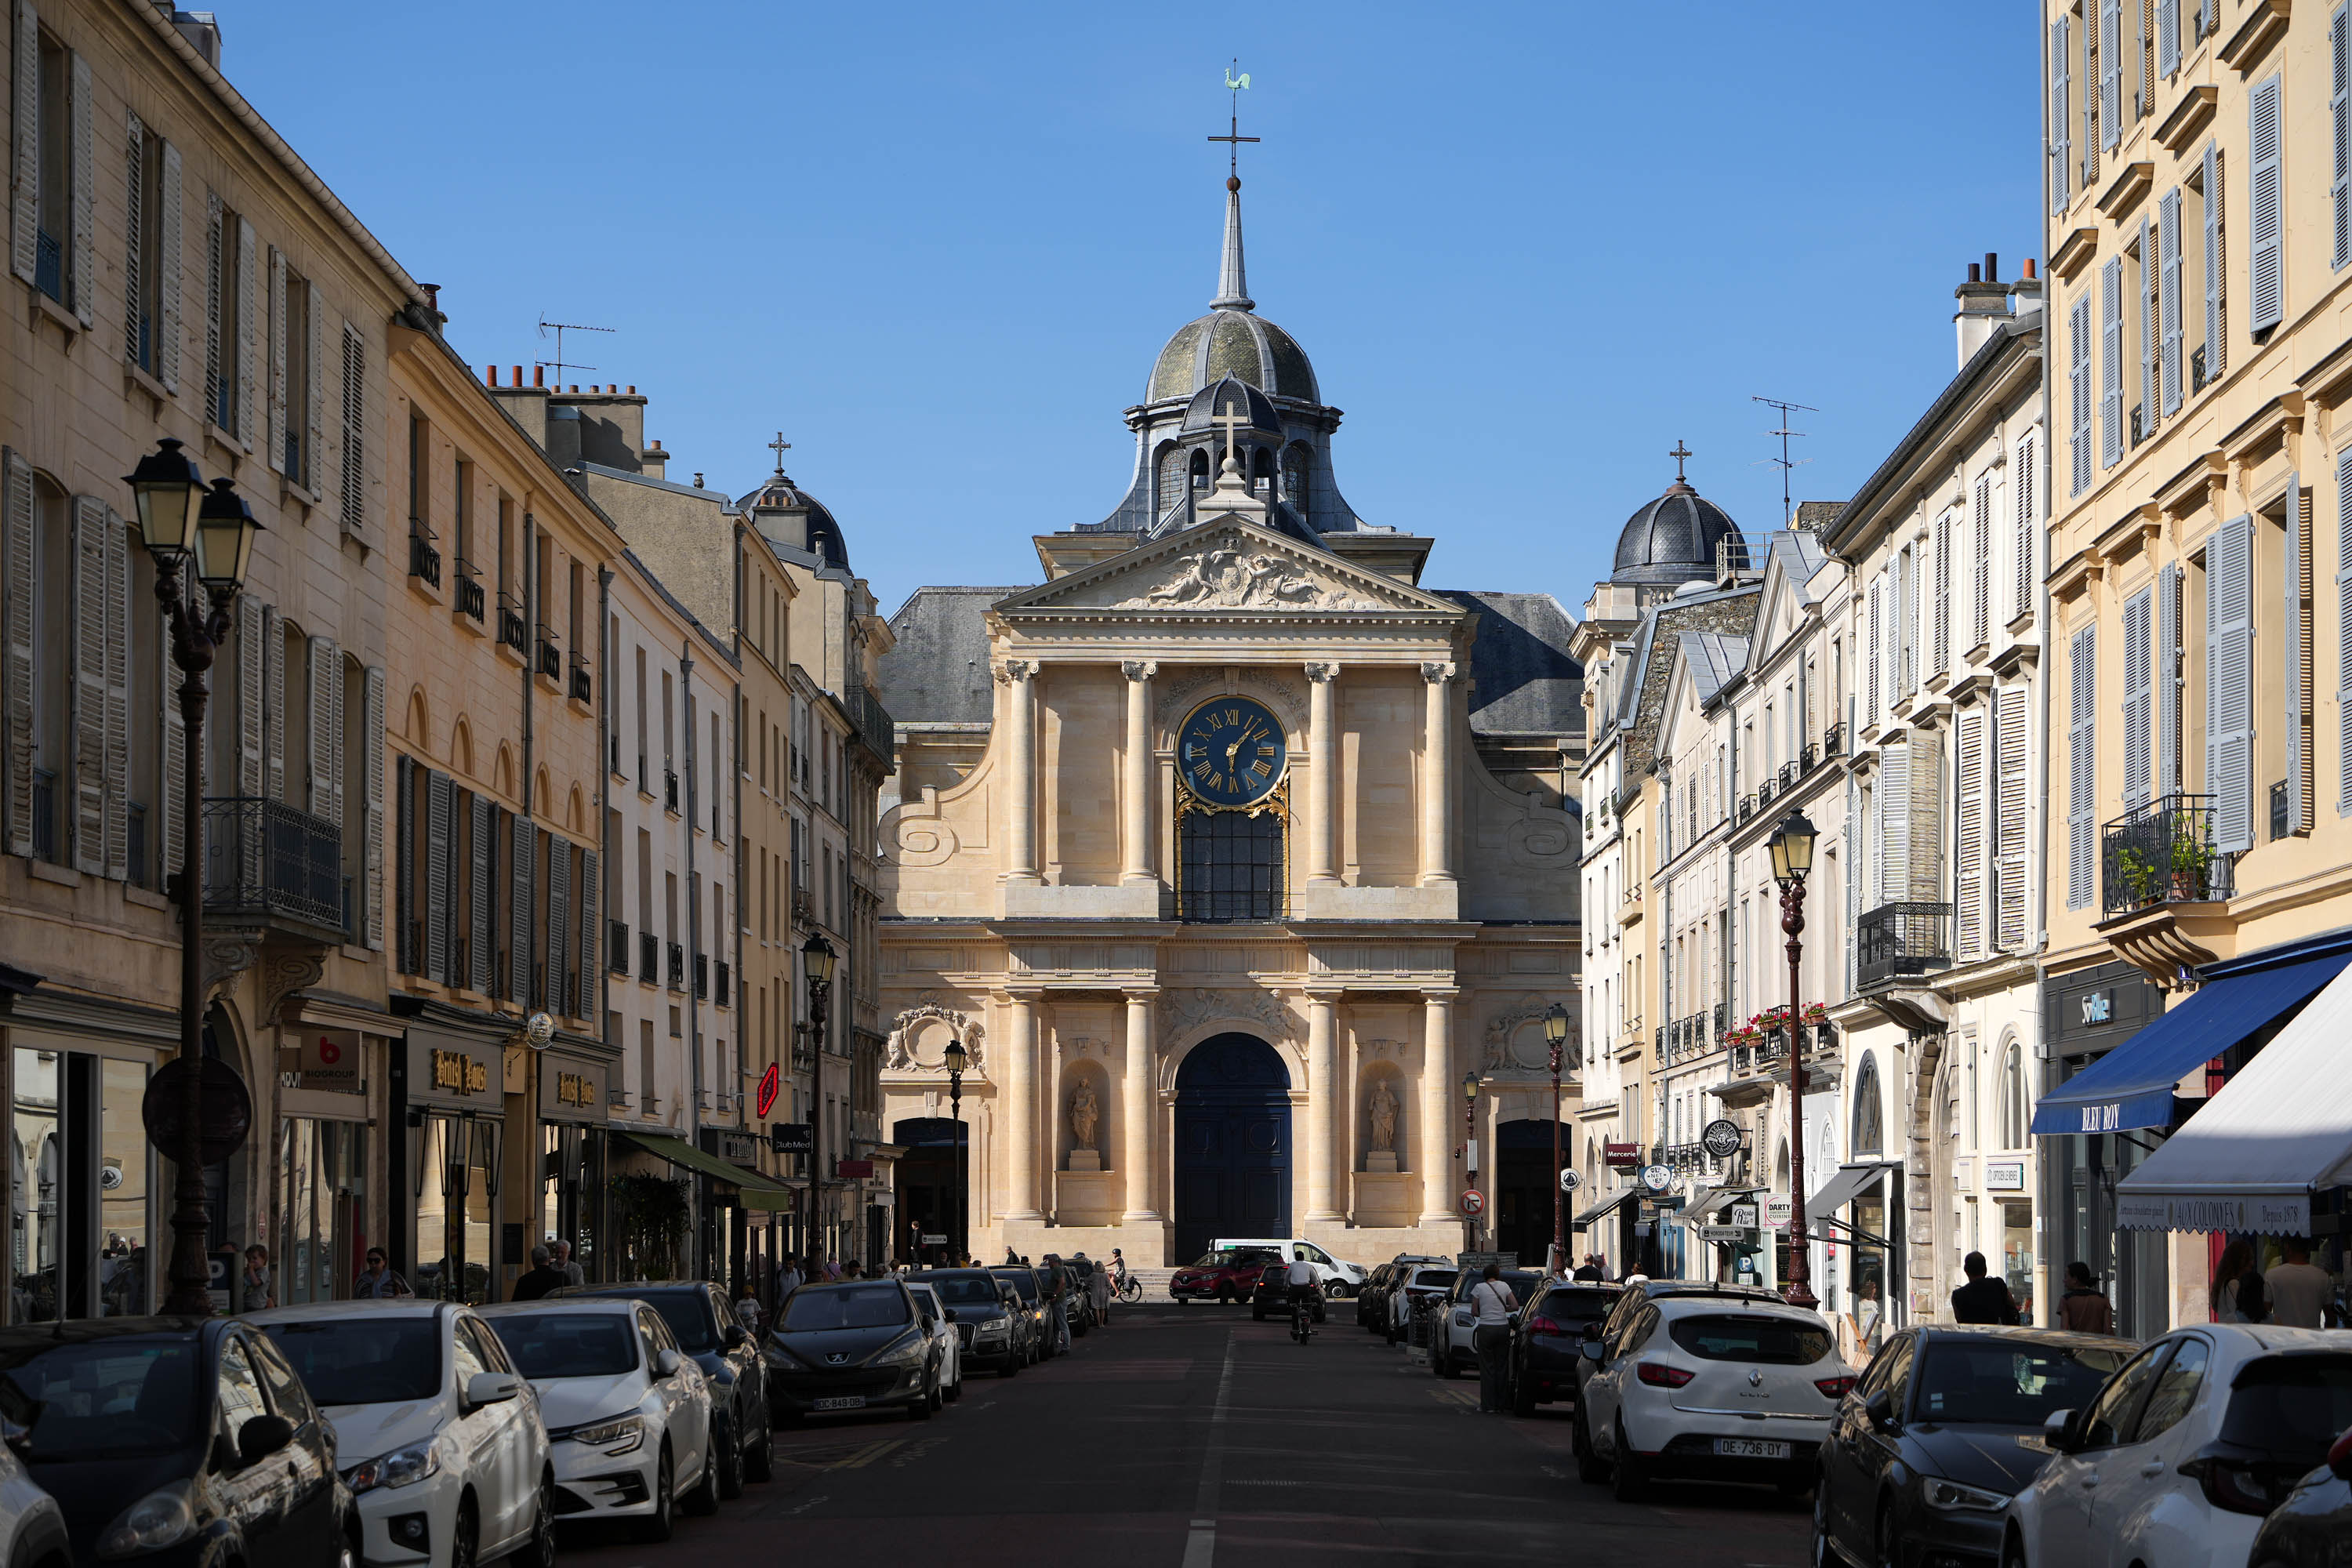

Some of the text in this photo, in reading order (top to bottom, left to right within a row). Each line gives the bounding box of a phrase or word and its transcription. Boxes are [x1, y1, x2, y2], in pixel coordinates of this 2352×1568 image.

[1206, 713, 1223, 731] XI
[1225, 709, 1240, 725] XII
[1193, 728, 1212, 742] X
[1253, 728, 1270, 740] II
[1190, 746, 1207, 757] IX
[1258, 746, 1275, 757] III
[1193, 760, 1212, 781] VIII
[1251, 759, 1272, 778] IIII
[1207, 771, 1223, 791] VII
[1228, 777, 1240, 793] VI
[1244, 774, 1258, 790] V
[305, 1069, 355, 1079] BIOGROUP
[433, 1049, 488, 1096] British House
[2082, 1103, 2120, 1131] BLEU ROY
[1709, 1123, 1736, 1138] BAGELSTEIN
[2176, 1201, 2192, 1225] AUX
[2263, 1205, 2299, 1229] Depuis 1978
[1742, 1257, 1751, 1269] P
[1722, 1440, 1781, 1456] DE-736-DY
